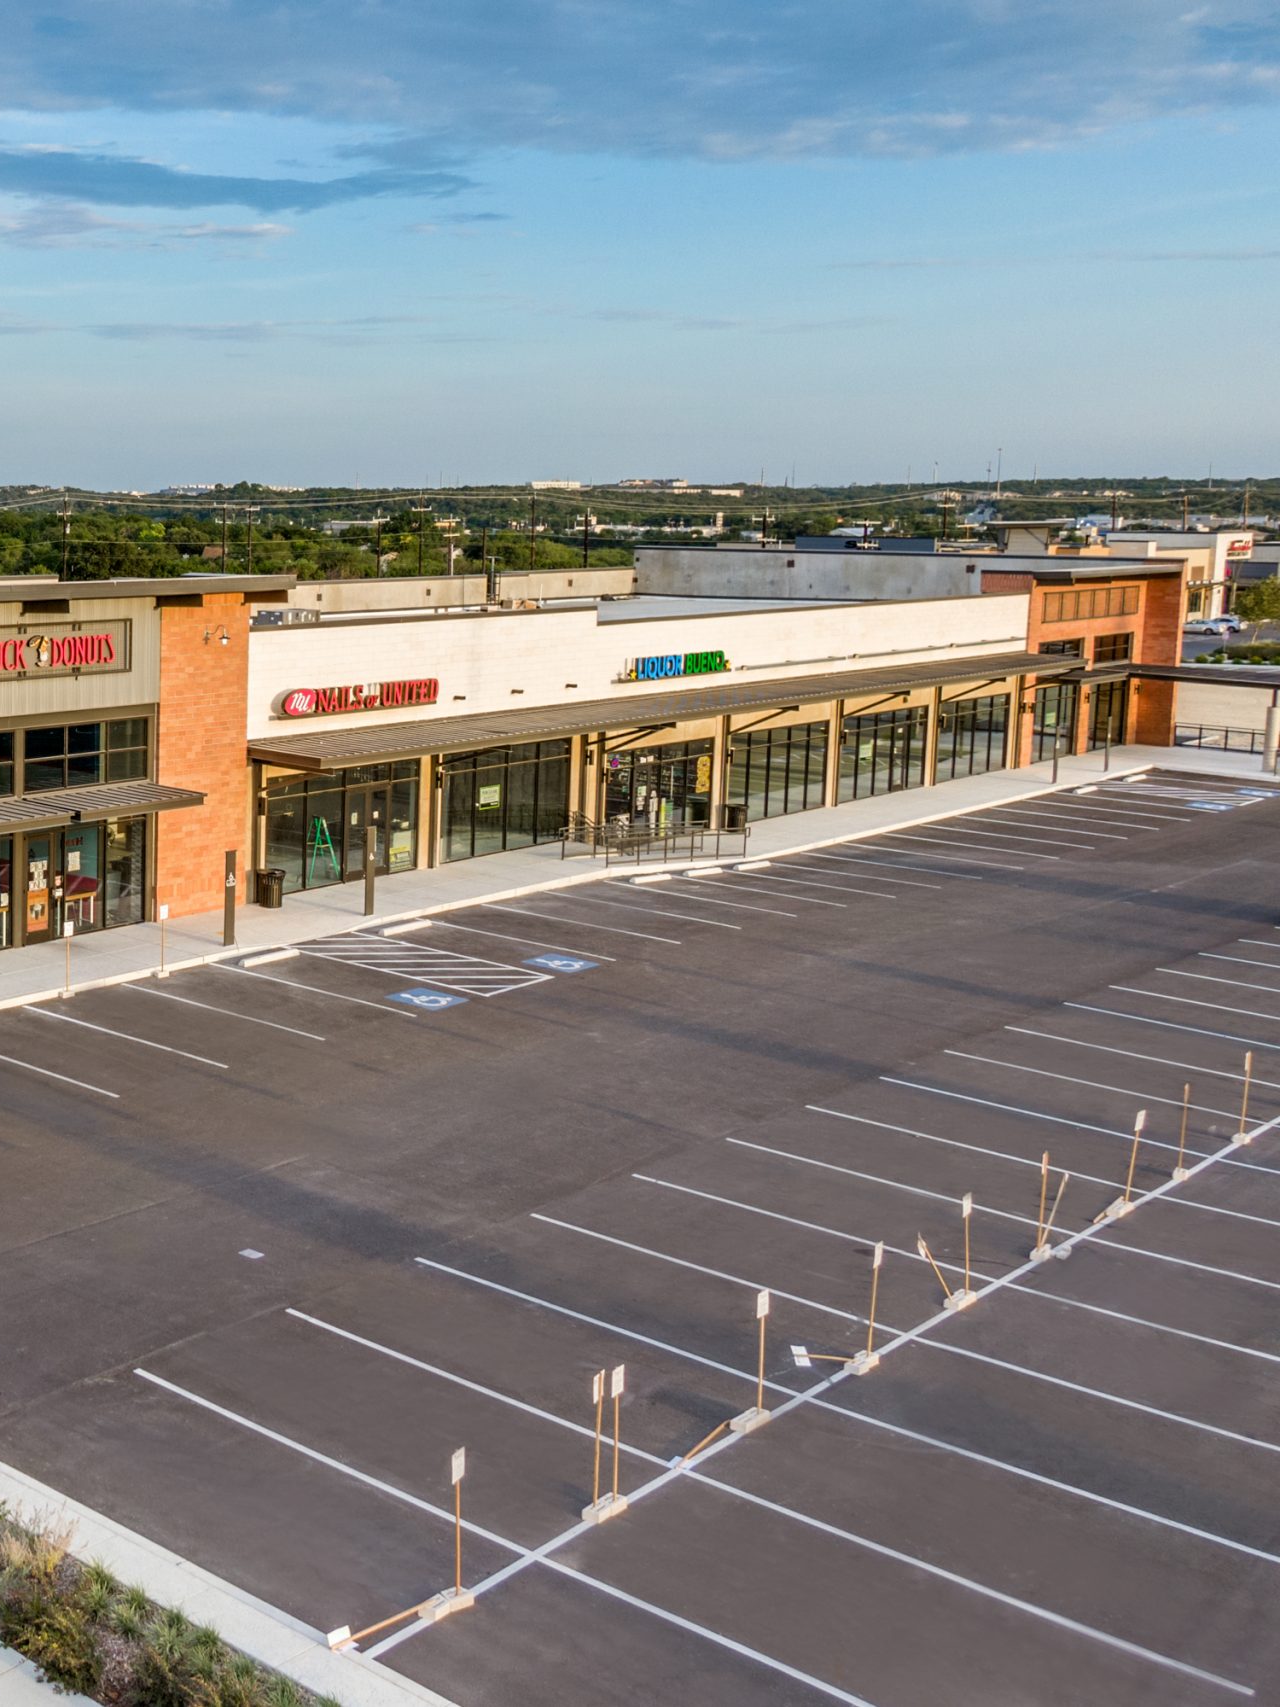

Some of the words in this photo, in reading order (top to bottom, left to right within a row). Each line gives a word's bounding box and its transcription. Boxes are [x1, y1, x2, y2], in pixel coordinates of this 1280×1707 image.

[51, 634, 114, 667] DONUTS
[636, 655, 682, 680] LIQUOR
[685, 651, 725, 673] BUENO
[316, 685, 364, 712] NAILS
[382, 679, 439, 706] UNITED
